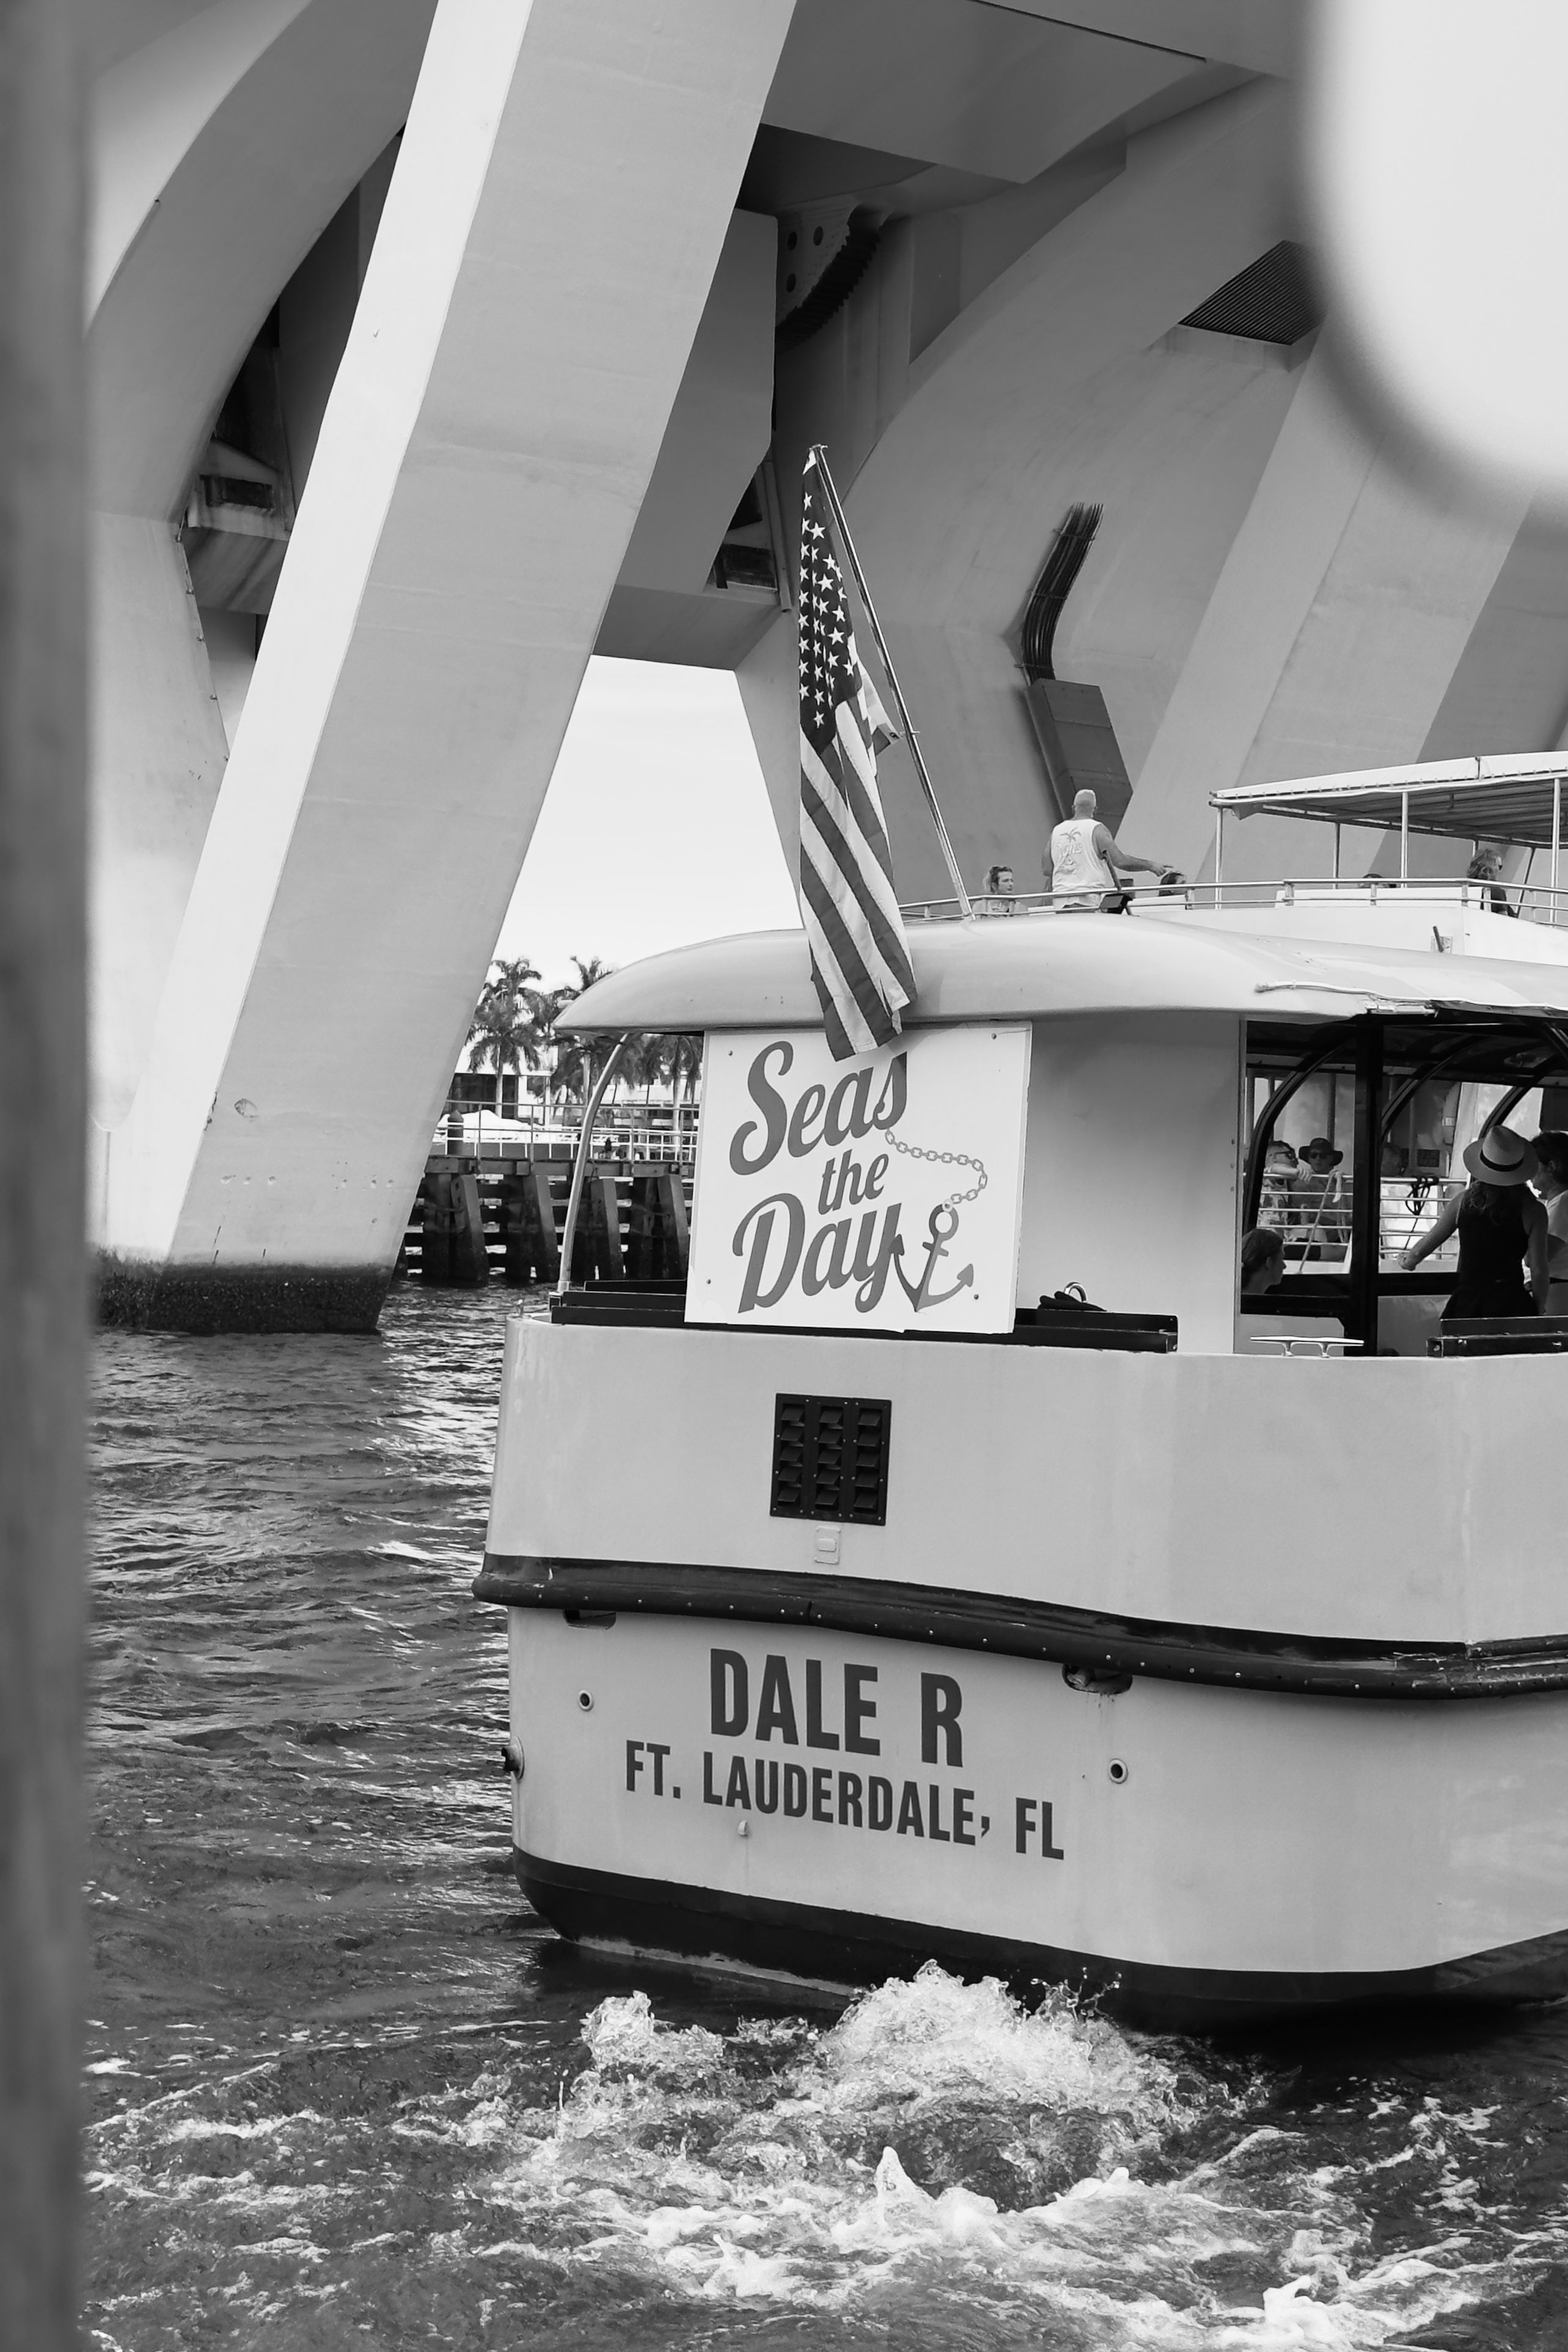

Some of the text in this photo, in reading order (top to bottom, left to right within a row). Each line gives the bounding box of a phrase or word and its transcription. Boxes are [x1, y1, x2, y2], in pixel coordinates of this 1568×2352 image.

[730, 1041, 907, 1175] Seas
[818, 1149, 888, 1215] the
[732, 1193, 902, 1313] Day
[711, 1649, 962, 1767] DALE R
[627, 1740, 1064, 1859] FT. LAUDERDALE, FL
